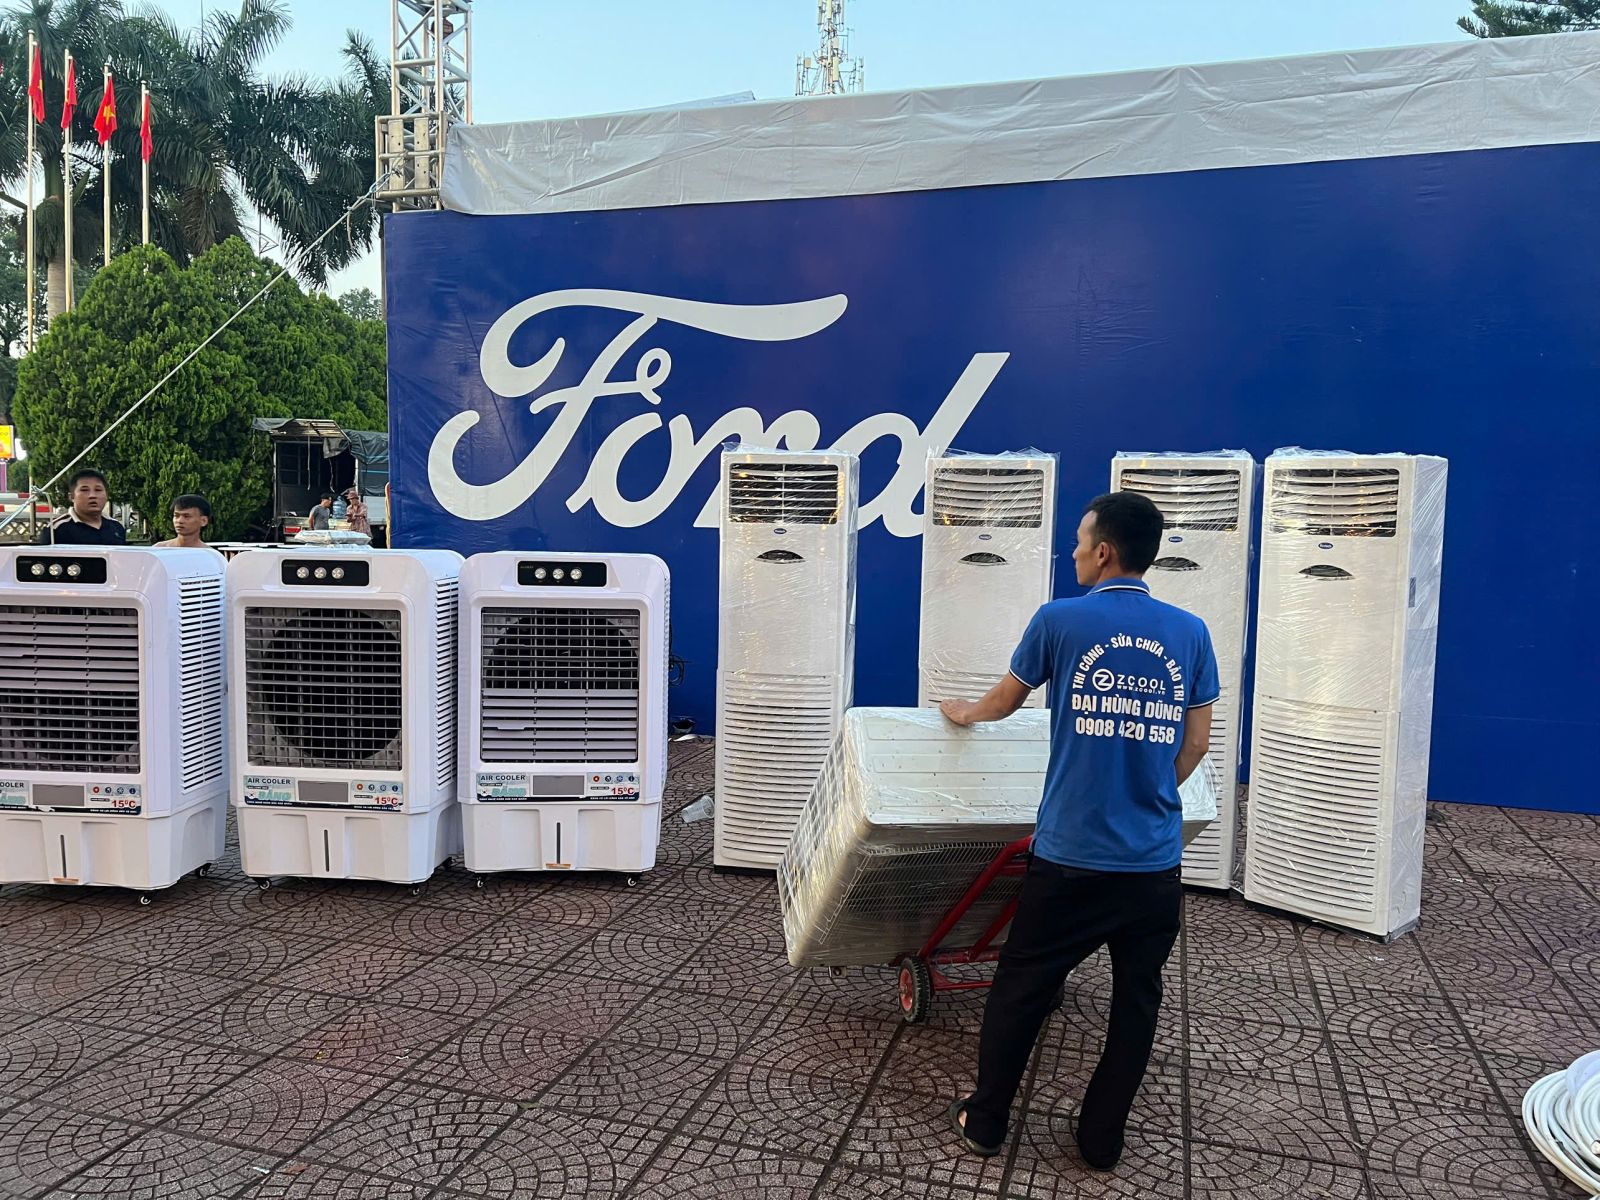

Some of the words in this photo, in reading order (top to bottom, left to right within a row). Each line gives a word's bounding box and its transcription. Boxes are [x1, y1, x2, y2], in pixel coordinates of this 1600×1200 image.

[428, 289, 1010, 537] Ford
[1072, 672, 1086, 689] THI
[1079, 644, 1105, 672] CÔNG
[1110, 632, 1132, 648] SỬA
[1136, 637, 1164, 658] CHỮA
[1166, 658, 1182, 682] BẢO
[1117, 674, 1166, 690] ZCOOL
[1072, 694, 1097, 715] ĐẠI
[1101, 694, 1141, 717] HÙNG
[1144, 700, 1183, 722] DŨNG
[1076, 716, 1115, 737] 0908
[1118, 720, 1145, 740] 420
[1148, 725, 1176, 744] 558
